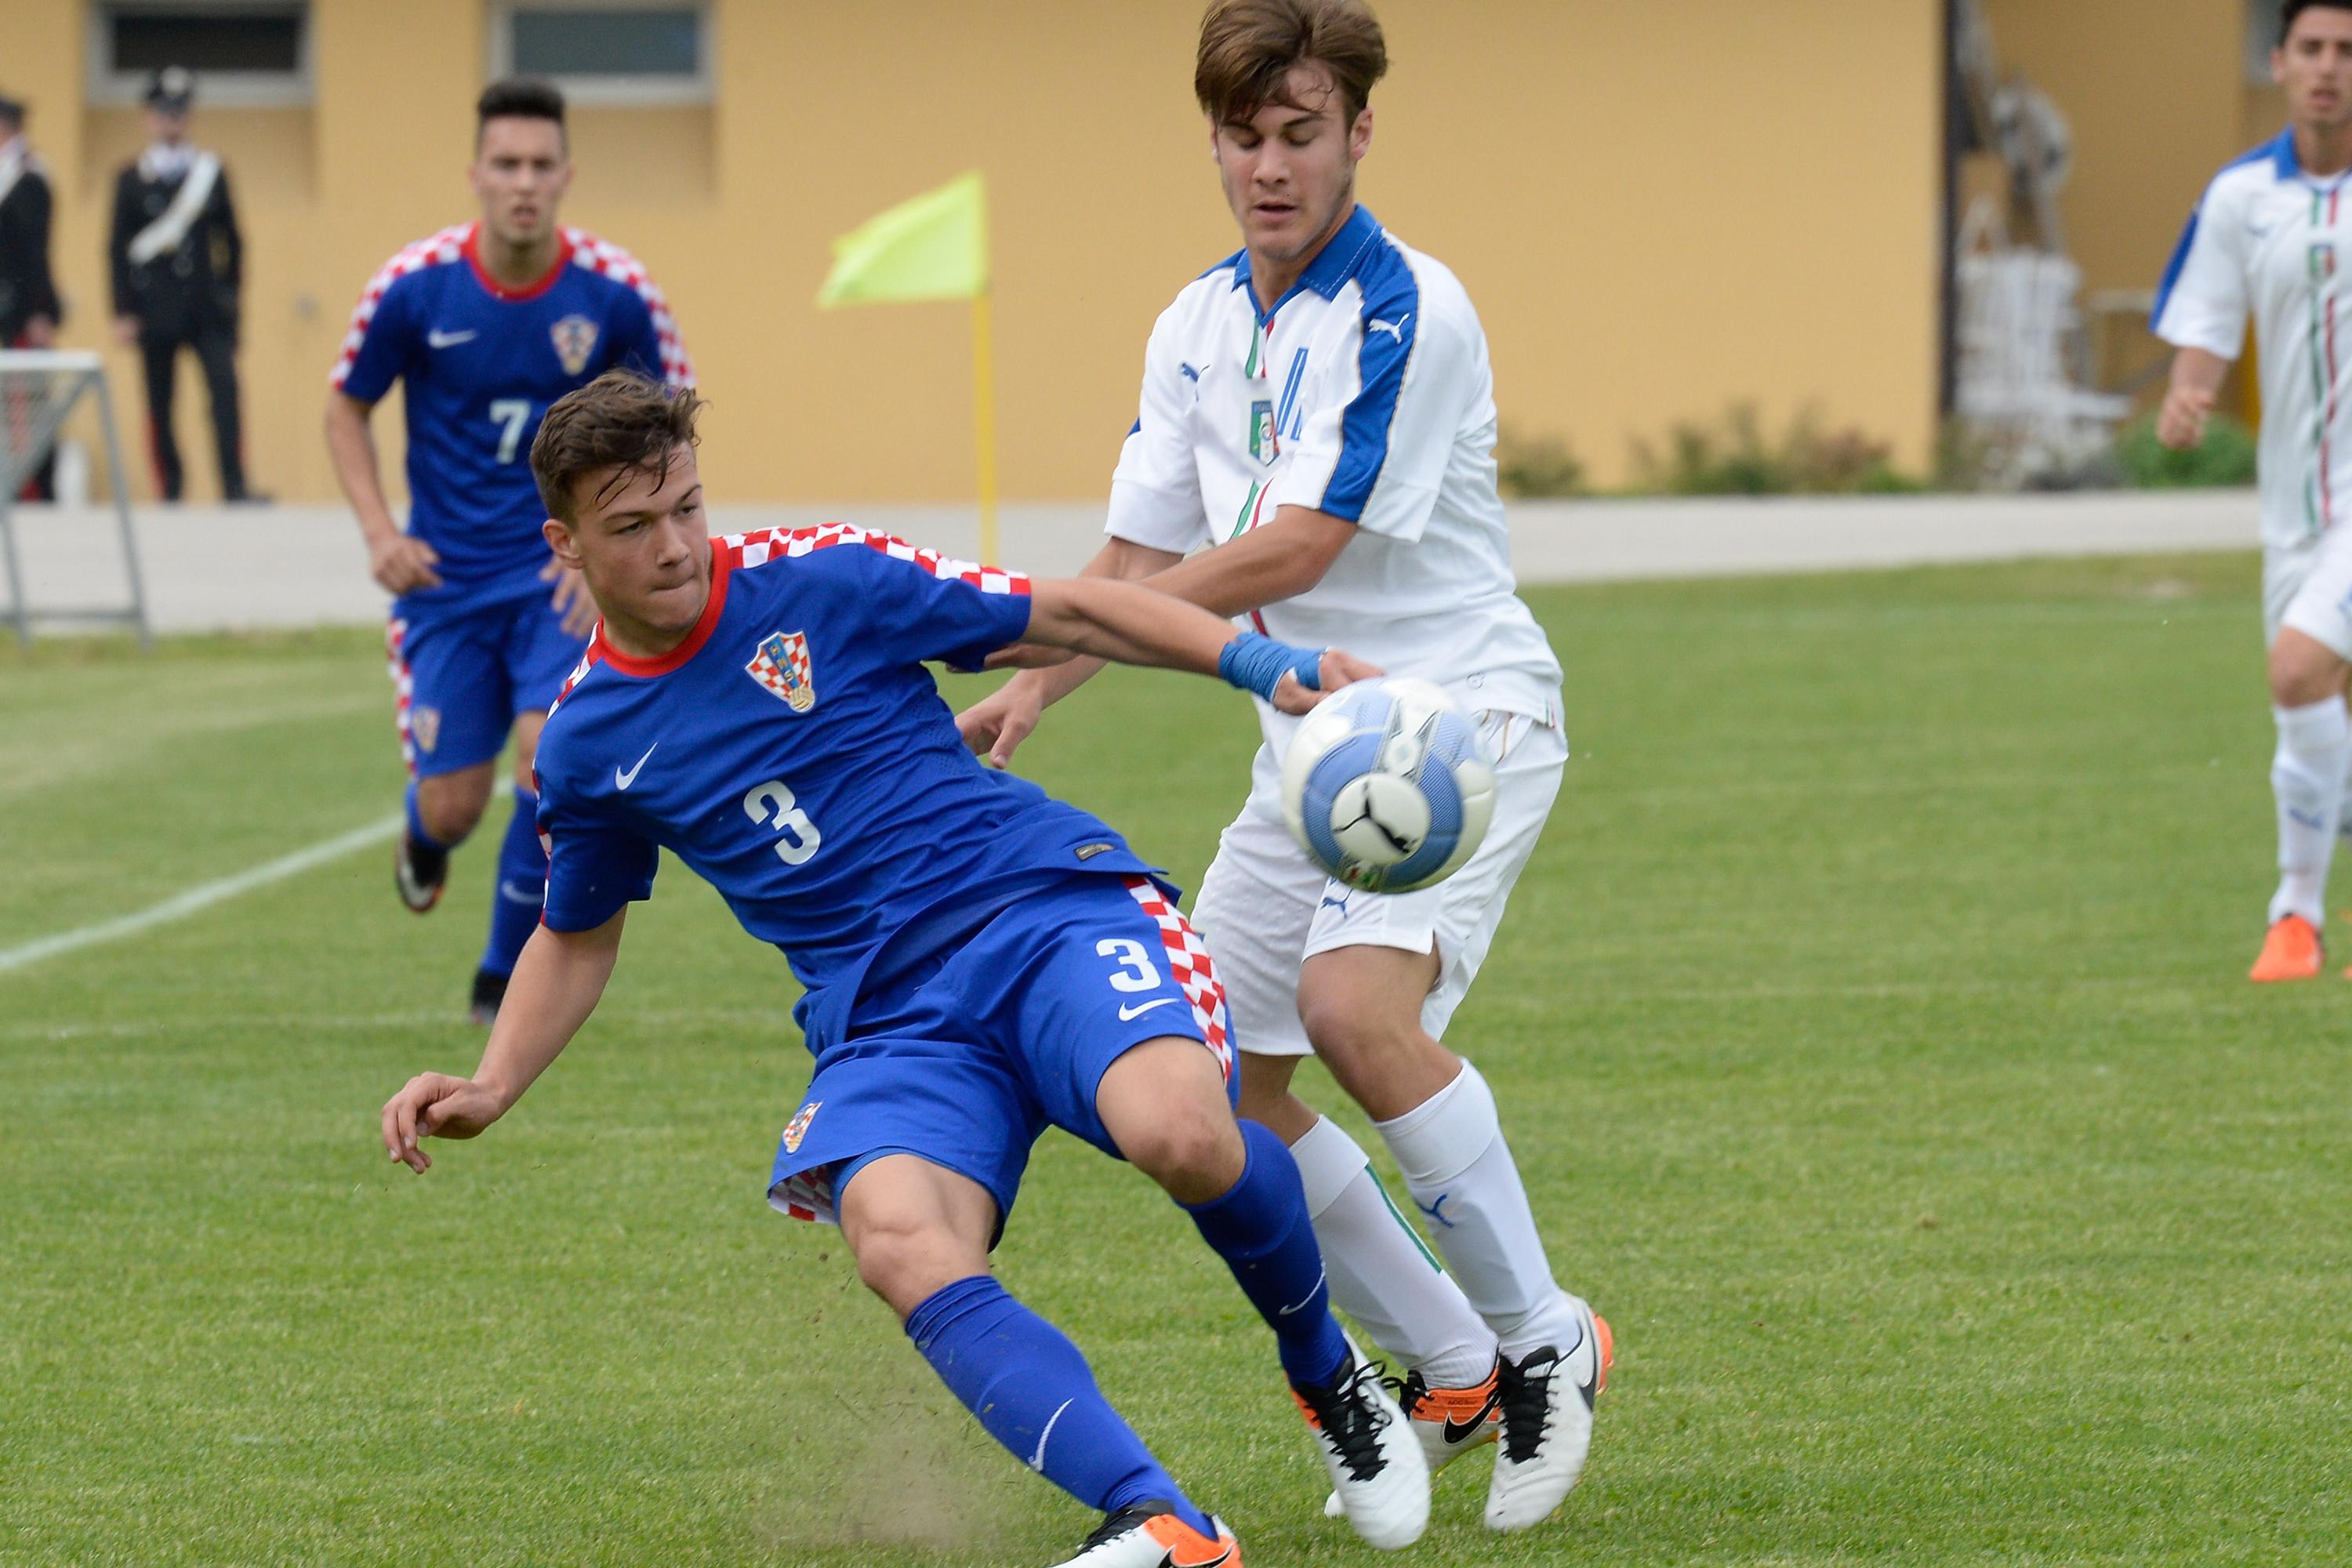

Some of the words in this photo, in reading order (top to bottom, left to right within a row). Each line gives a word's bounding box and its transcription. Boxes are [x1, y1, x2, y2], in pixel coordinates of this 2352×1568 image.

[489, 400, 531, 464] 7
[743, 780, 821, 866] 3
[1096, 938, 1161, 993] 3
